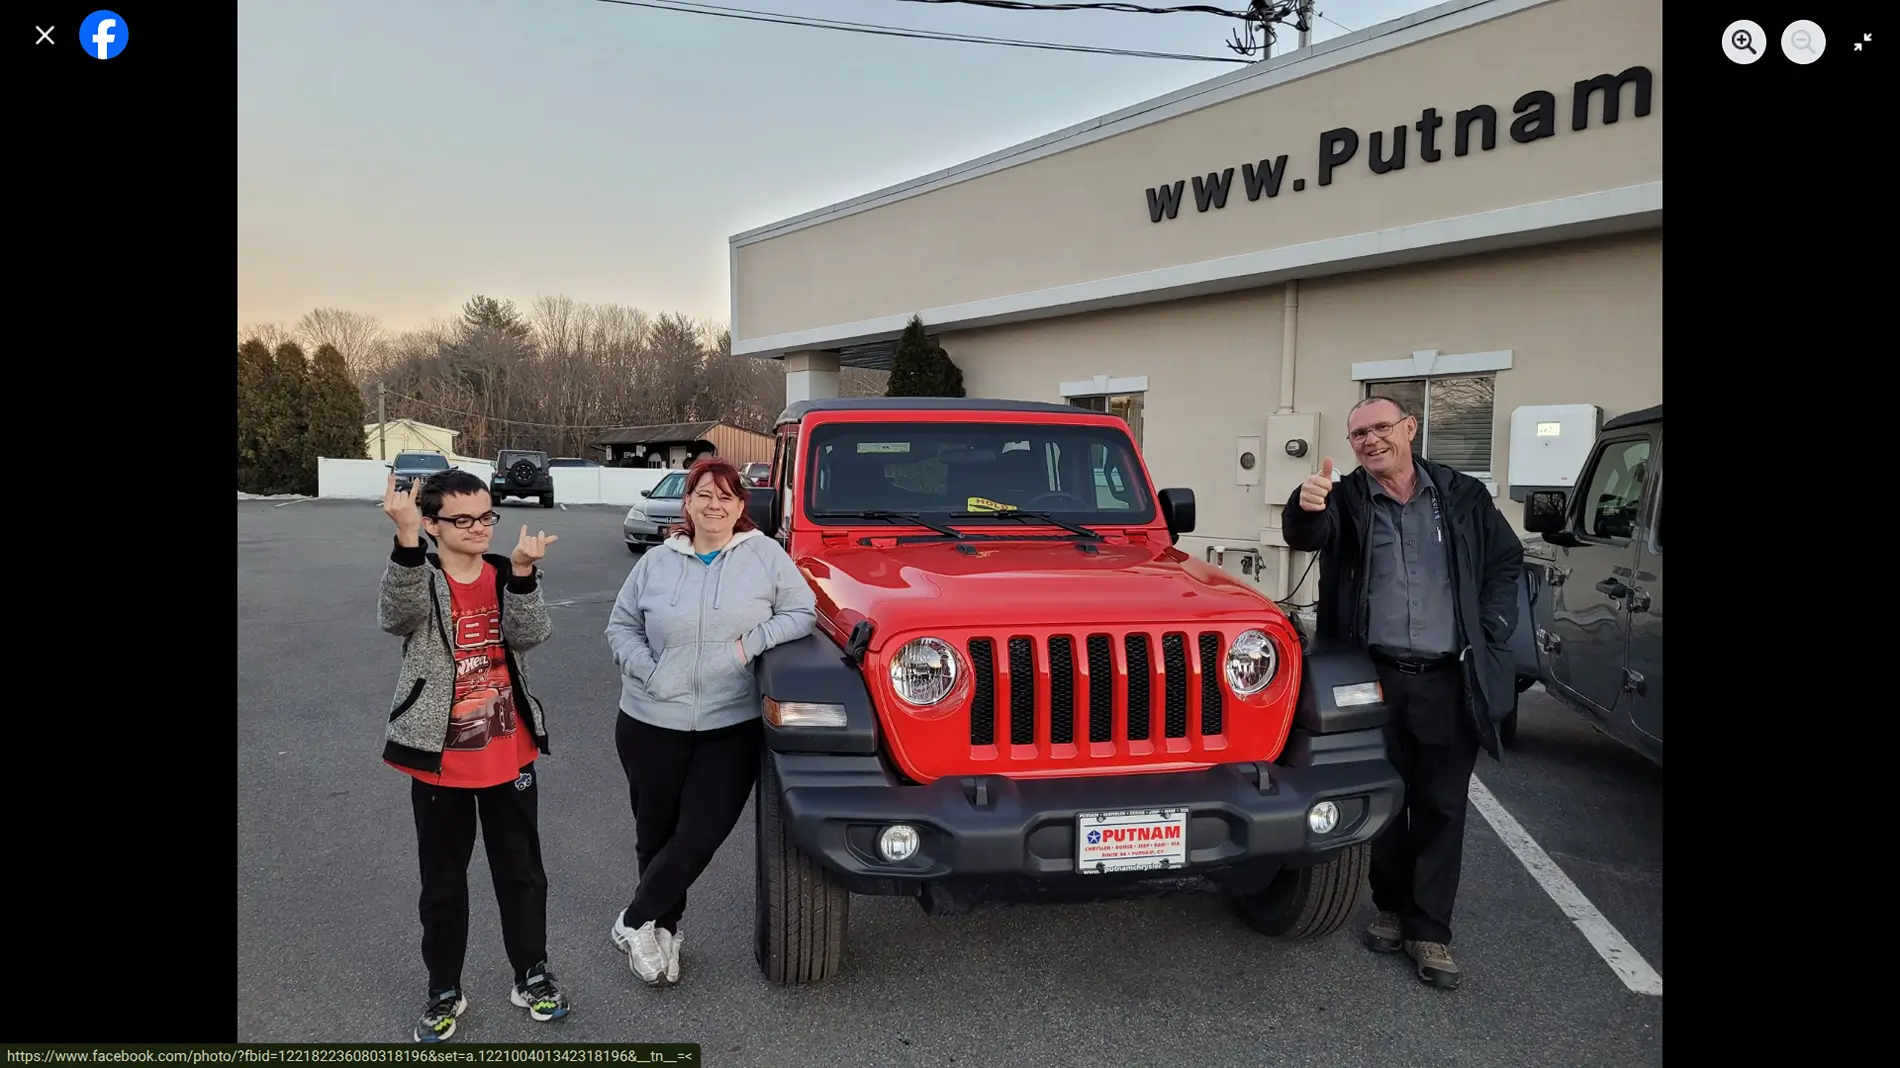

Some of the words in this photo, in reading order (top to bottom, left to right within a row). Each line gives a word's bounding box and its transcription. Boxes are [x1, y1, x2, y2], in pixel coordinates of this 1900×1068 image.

[1145, 65, 1653, 223] www.Putnam
[976, 499, 1008, 510] HOLD
[1102, 825, 1181, 843] PUTNAM
